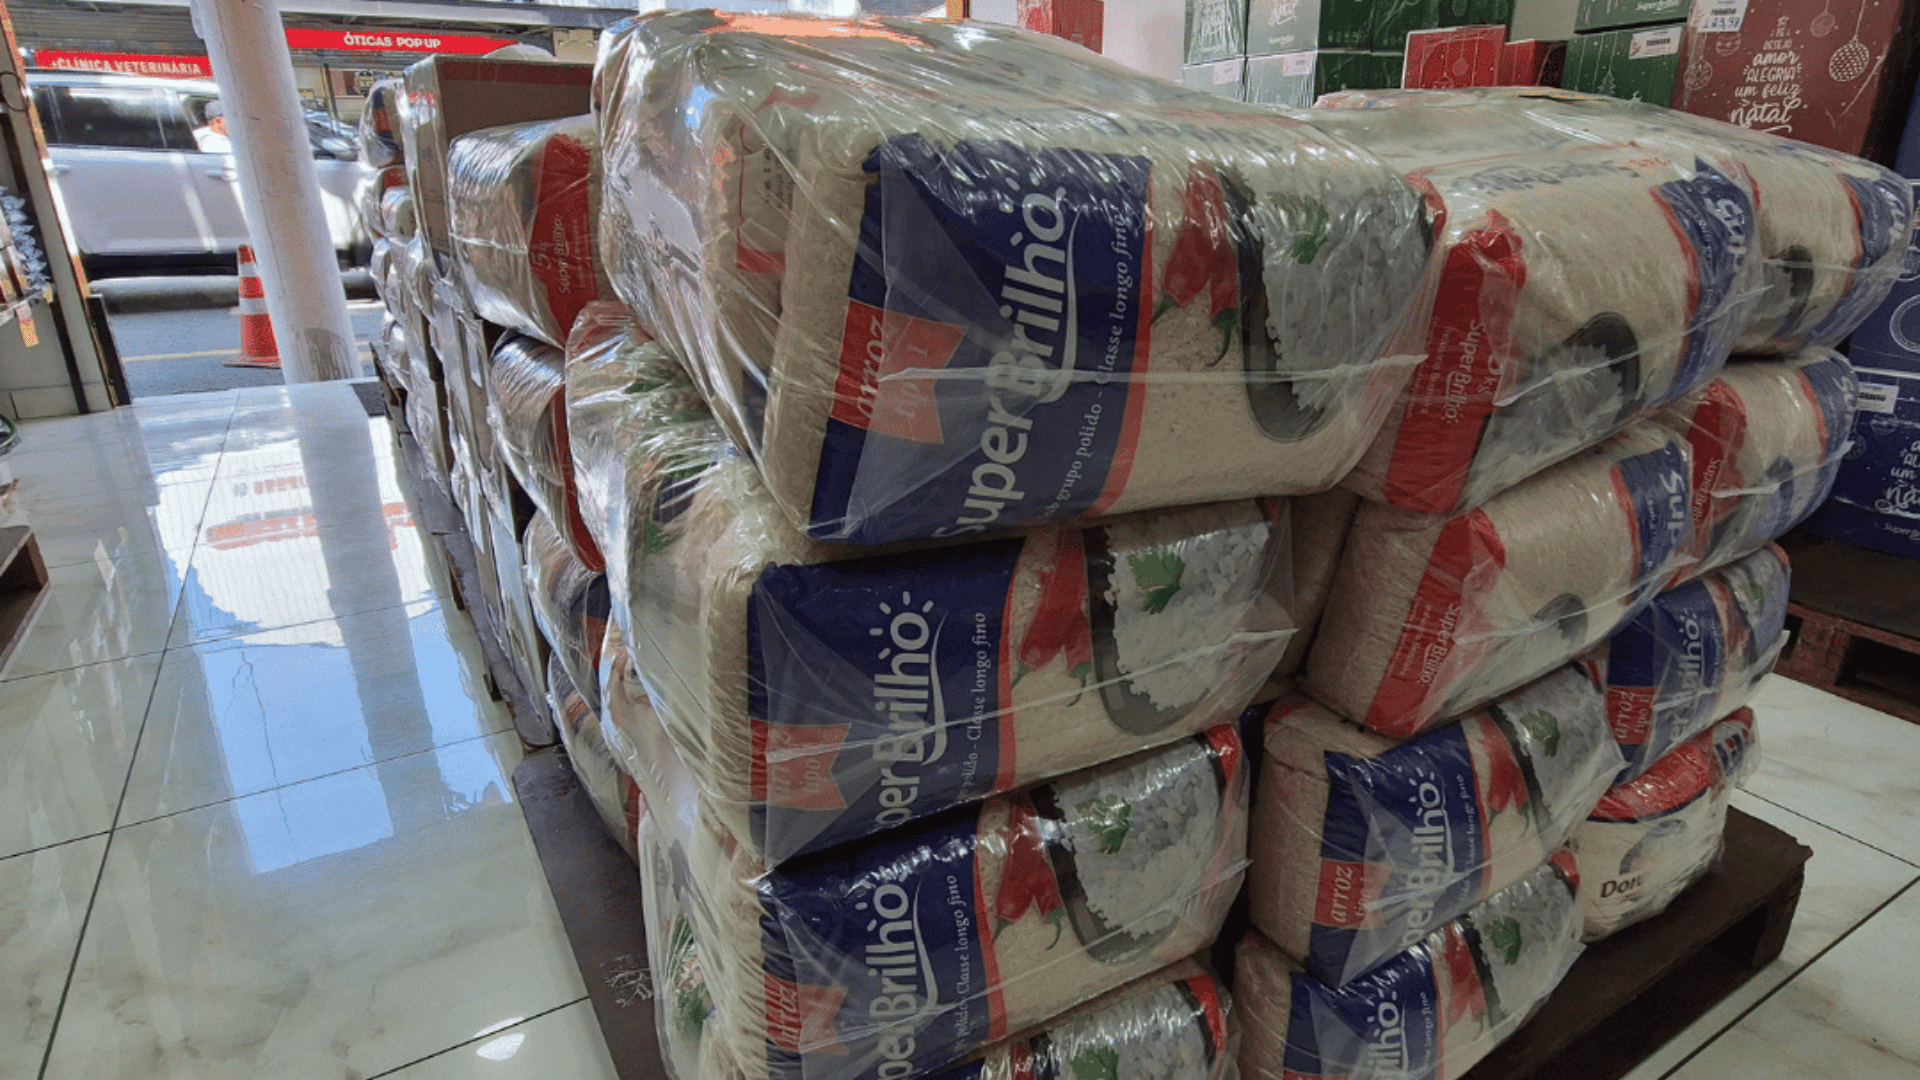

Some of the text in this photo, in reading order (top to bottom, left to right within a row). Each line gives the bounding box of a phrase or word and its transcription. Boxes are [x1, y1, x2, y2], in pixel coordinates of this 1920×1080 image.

[343, 31, 393, 47] ÓTICAS
[1752, 50, 1800, 66] amor
[57, 56, 203, 75] CLÍNICA VETERINÁRIA
[1745, 65, 1796, 82] ALEGRIA
[1734, 81, 1803, 99] um feliz
[1730, 97, 1802, 128] natal
[1056, 459, 1083, 503] grupo
[1075, 403, 1104, 459] polido
[1109, 261, 1134, 321] longo
[971, 612, 992, 647] fino
[970, 650, 991, 693] longo
[966, 696, 986, 741] Classe
[1614, 690, 1636, 740] arroz
[767, 728, 792, 802] arrz
[1456, 773, 1472, 800] fino
[946, 874, 967, 907] fino
[1330, 864, 1355, 924] arroz
[954, 909, 970, 951] longo
[865, 883, 919, 1018] Brilho
[955, 953, 971, 995] Classe
